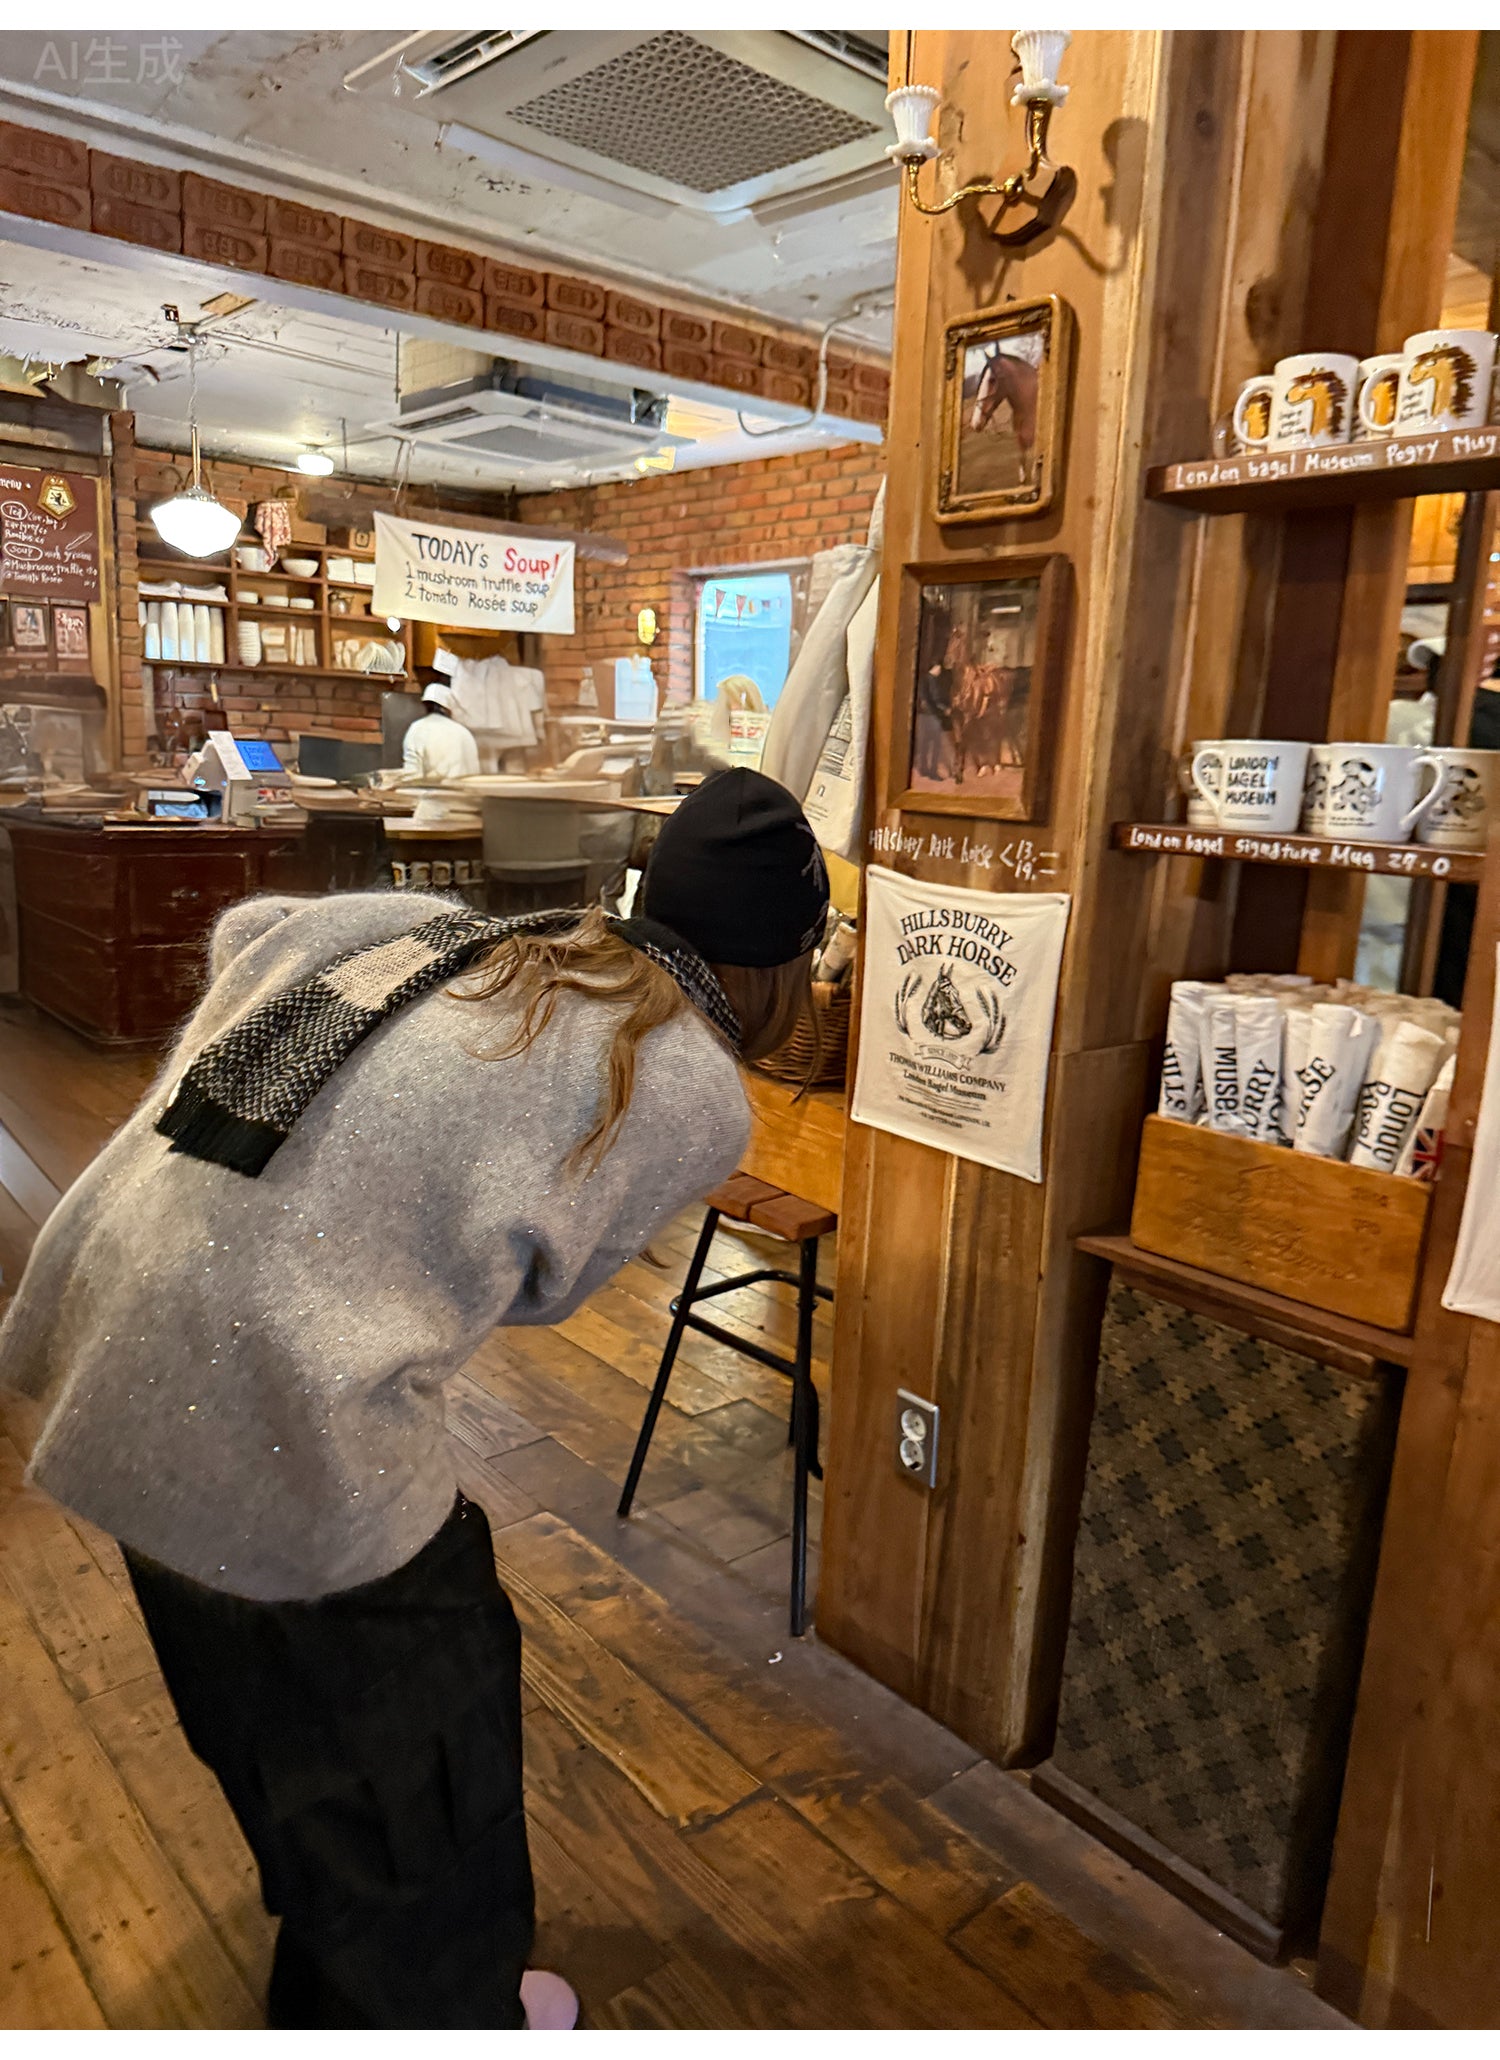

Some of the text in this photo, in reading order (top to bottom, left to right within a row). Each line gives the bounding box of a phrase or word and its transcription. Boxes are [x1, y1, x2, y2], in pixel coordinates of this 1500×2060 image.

[1176, 461, 1240, 489] London
[1303, 450, 1374, 471] Museum
[1452, 433, 1497, 457] Mug
[503, 547, 560, 581] Soup!
[417, 568, 479, 589] mushroom
[481, 575, 522, 594] truffle
[419, 585, 459, 606] tomato
[896, 934, 1018, 987] DARK HORSE
[959, 1074, 1007, 1093] COMPANY
